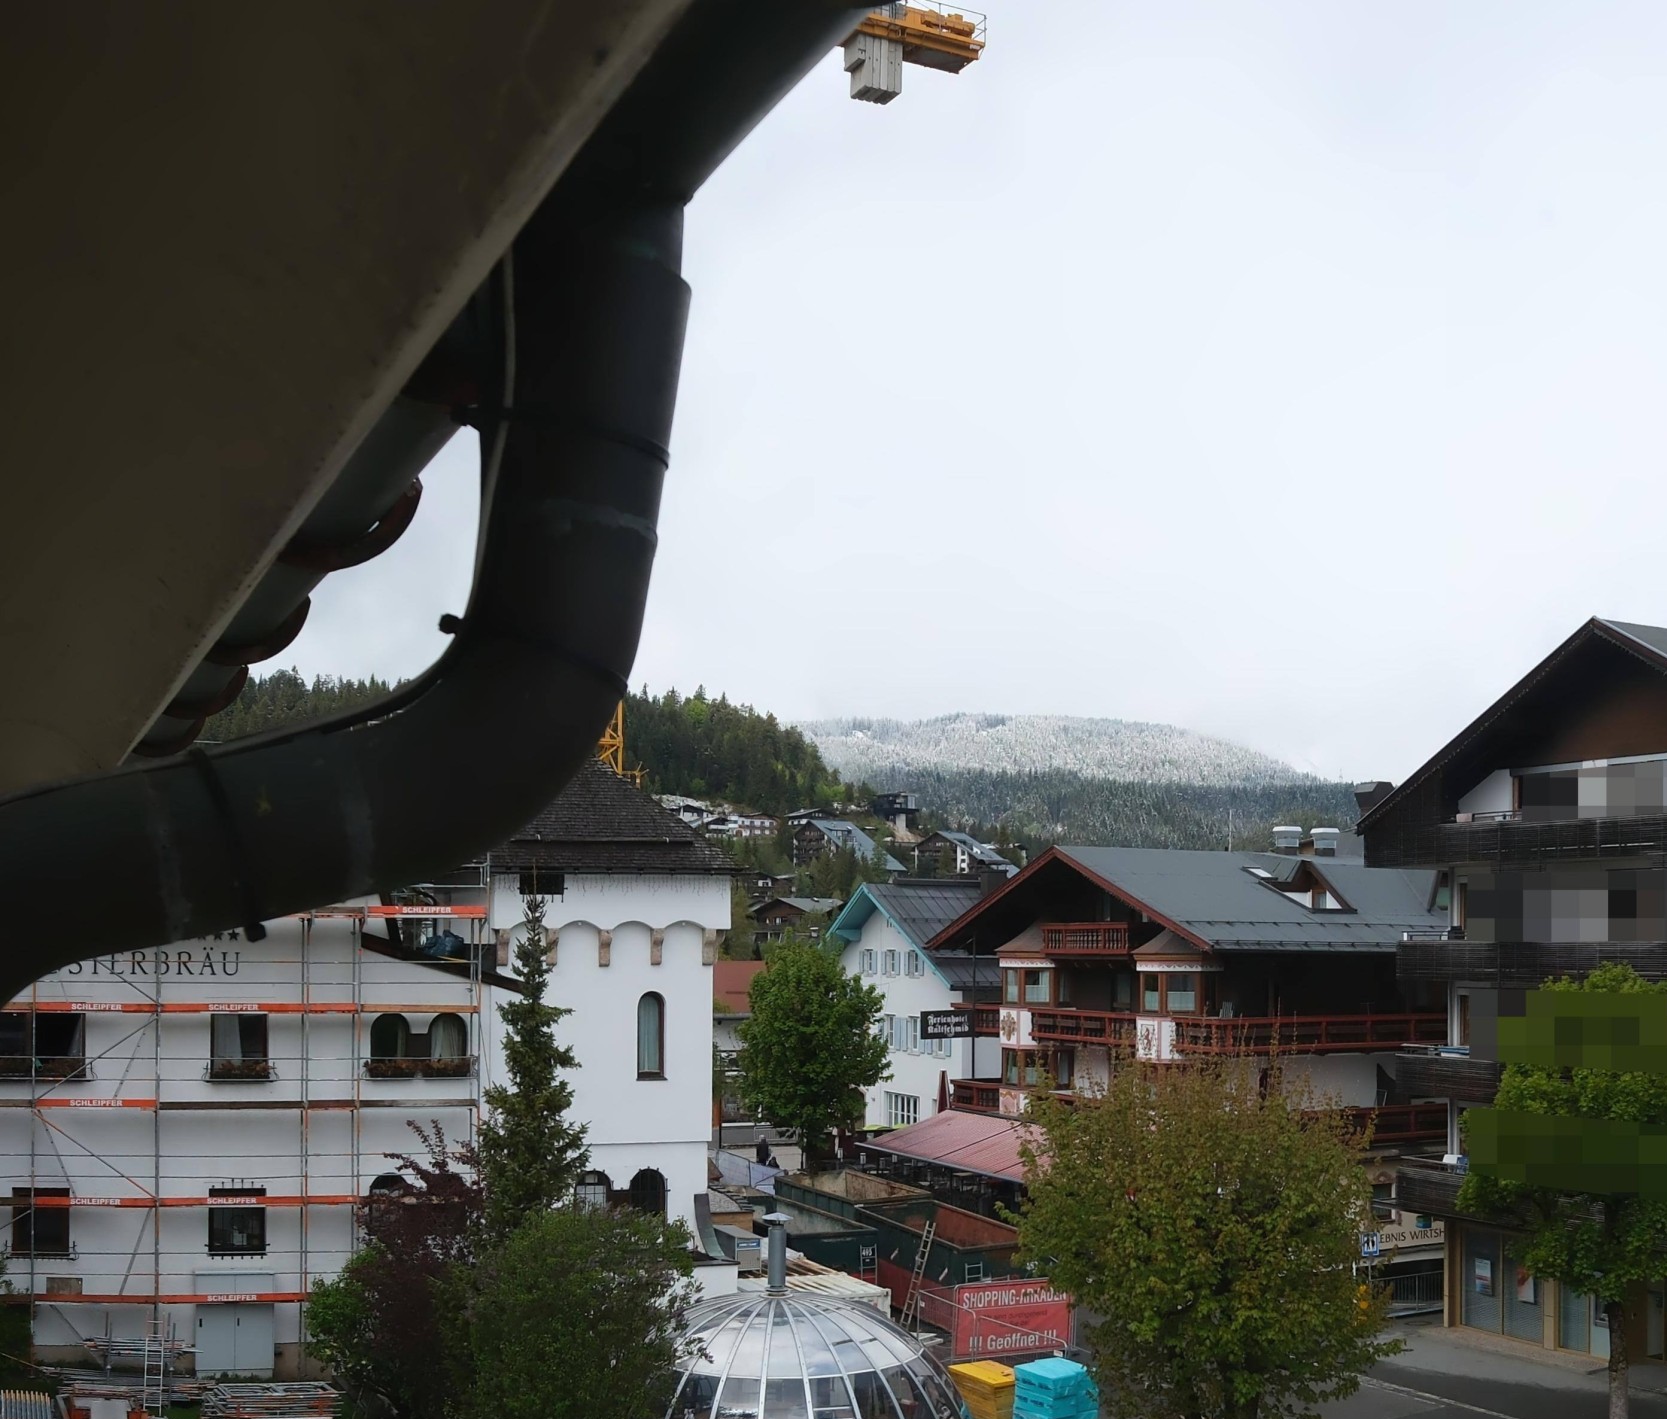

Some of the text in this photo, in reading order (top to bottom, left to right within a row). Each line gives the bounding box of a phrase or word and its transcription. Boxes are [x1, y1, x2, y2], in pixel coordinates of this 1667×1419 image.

[402, 906, 451, 914] SCHLEIPFER
[71, 1003, 122, 1011] SCHLEIPFER
[208, 1003, 259, 1011] SCHLEIPFER
[69, 1099, 123, 1107] SCHLEIPFER
[70, 1198, 121, 1206] SCHLEIPFER
[206, 1197, 257, 1205] SCHLEIPFER
[207, 1294, 257, 1302] SCHLEIPFER
[987, 1331, 1040, 1350] Geöffnet
